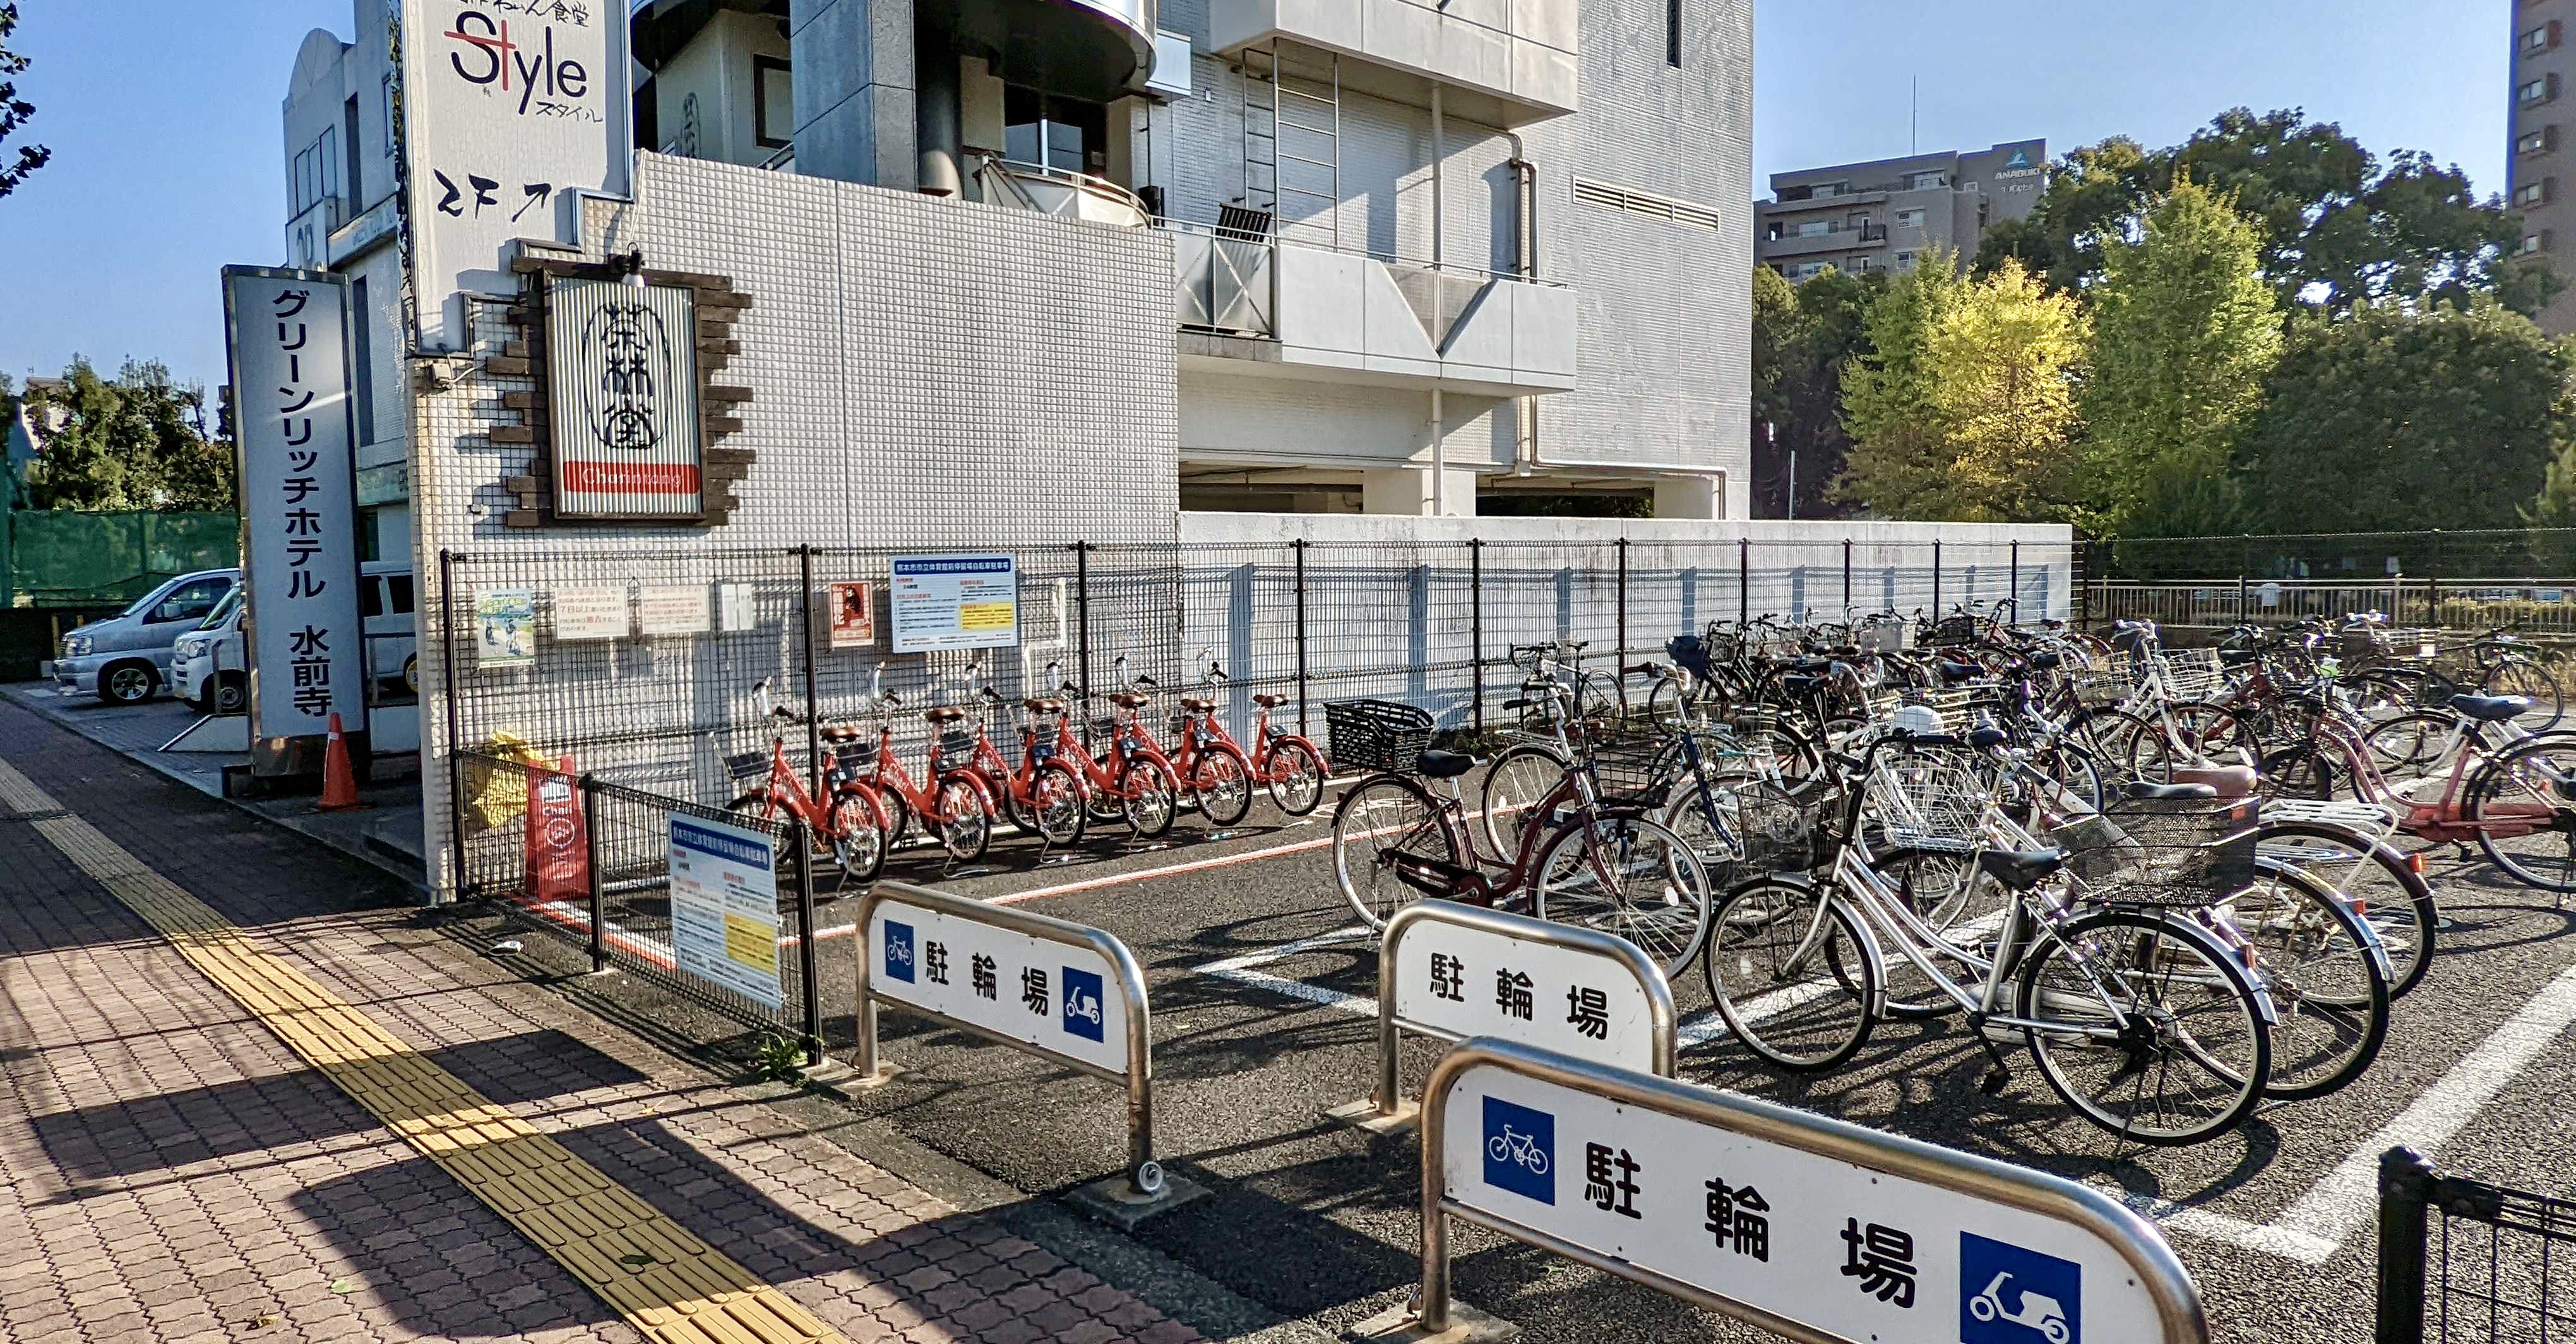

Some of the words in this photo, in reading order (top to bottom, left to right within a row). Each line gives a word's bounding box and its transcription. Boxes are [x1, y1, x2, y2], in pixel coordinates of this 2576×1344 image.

[444, 11, 587, 115] Style
[536, 101, 603, 122] スタイル
[433, 167, 499, 219] 2F
[273, 289, 327, 599] グリーンリッチホテル
[289, 624, 333, 717] 水前寺
[926, 941, 1049, 1016] 駐輪場
[1430, 952, 1609, 1040] 駐輪場
[1584, 1141, 1917, 1309] 駐輪場
